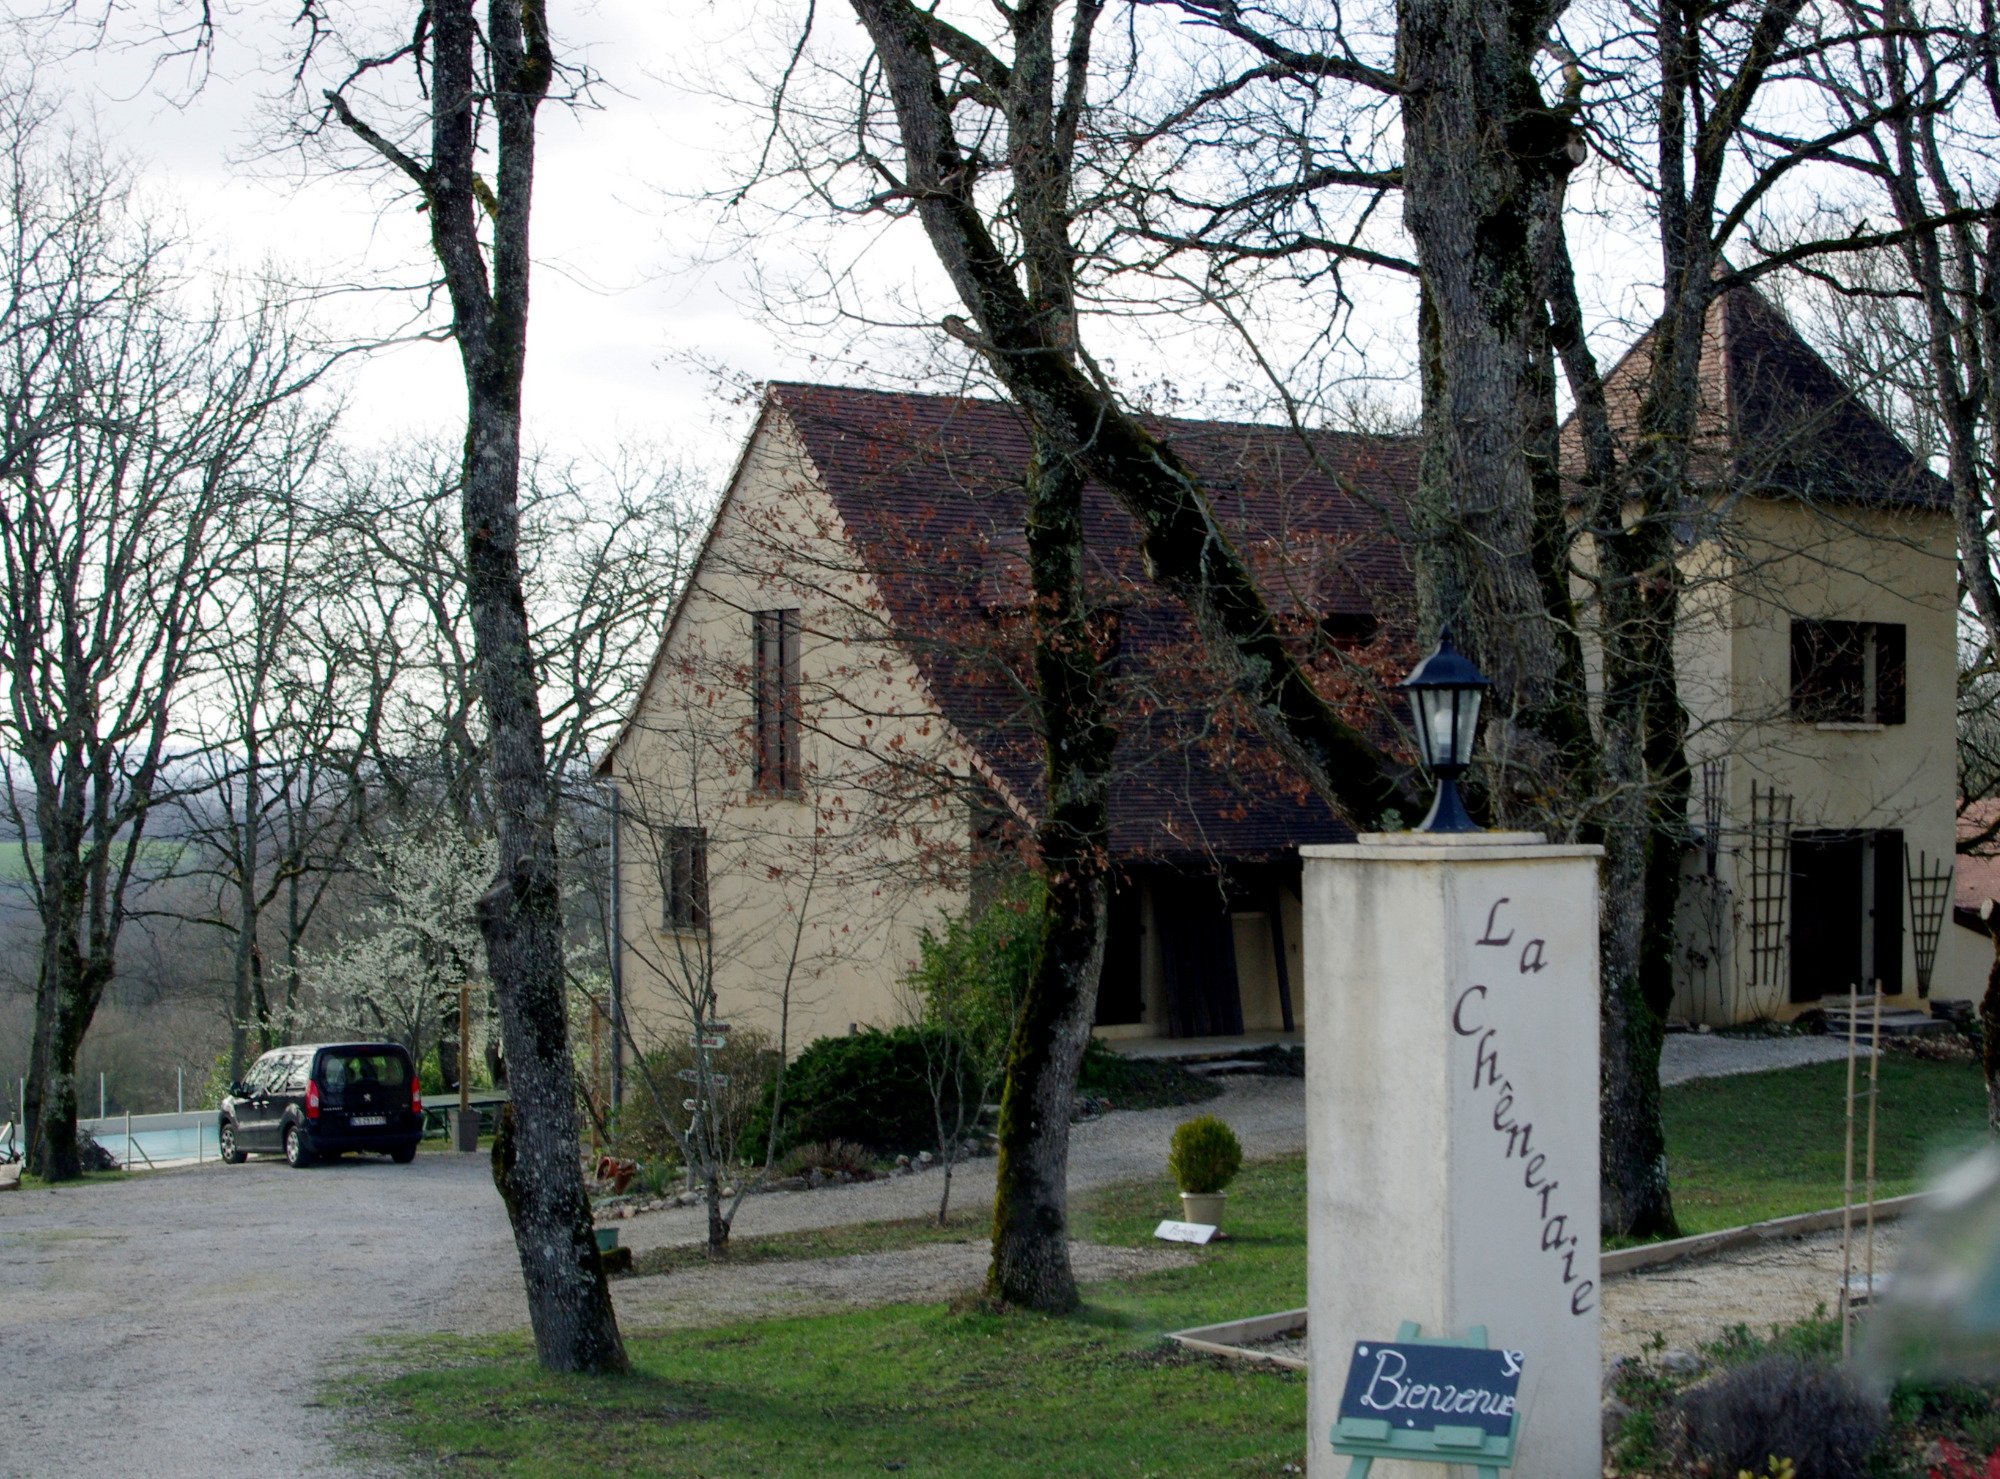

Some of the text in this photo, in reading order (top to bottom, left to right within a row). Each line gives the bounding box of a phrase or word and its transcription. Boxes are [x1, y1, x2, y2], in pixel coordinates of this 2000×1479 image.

[1453, 897, 1593, 1315] La Chêneraie
[1360, 1349, 1516, 1416] Bienvenue
